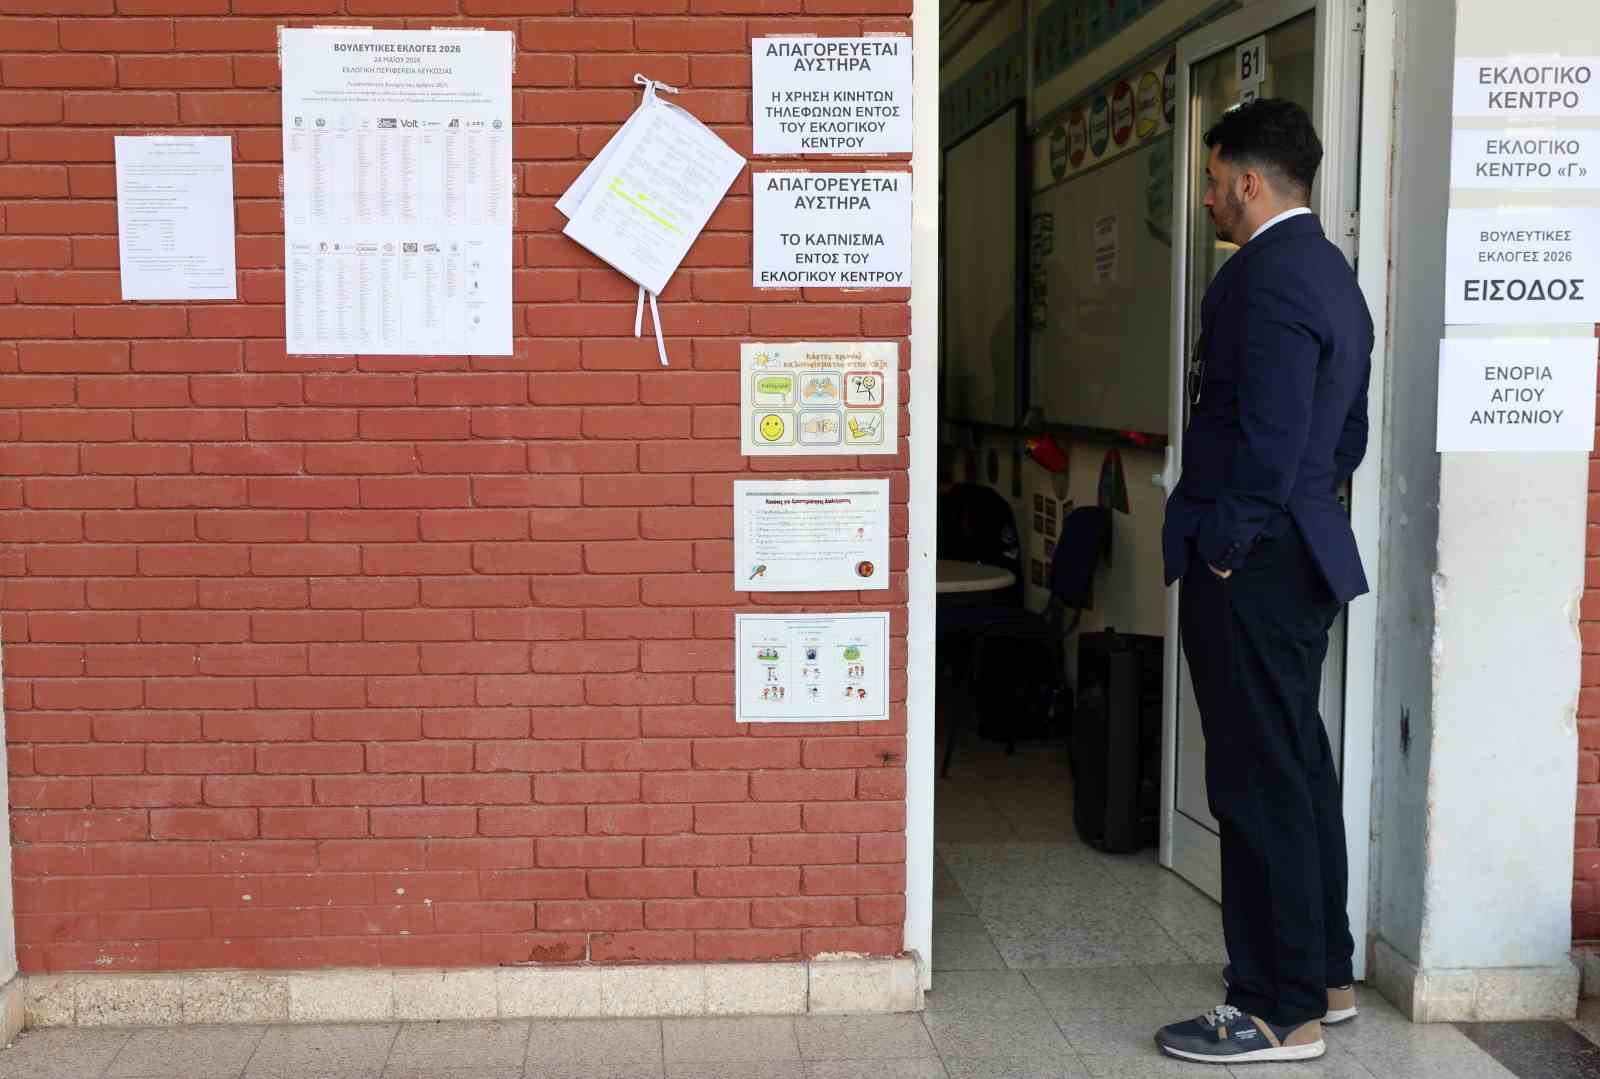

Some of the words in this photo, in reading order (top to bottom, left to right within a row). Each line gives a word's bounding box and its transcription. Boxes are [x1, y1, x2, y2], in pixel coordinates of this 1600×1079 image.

[334, 44, 395, 52] ΒΟΥΛΕΥΤΙΚΕΣ
[397, 44, 437, 53] ΕΚΛΟΓΕΣ
[439, 45, 461, 53] 2026
[766, 42, 898, 56] ΑΠΑΓΟΡΕΥΕΤΑΙ
[794, 58, 871, 72] ΑΥΣΤΗΡΑ
[1479, 66, 1592, 84] ΕΚΛΟΓΙΚΟ
[772, 92, 780, 102] Η
[785, 92, 829, 102] ΧΡΗΣΗ
[834, 91, 893, 102] ΚΙΝΗΤΩΝ
[1488, 91, 1579, 108] ΚΕΝΤΡΟ
[766, 106, 851, 117] ΤΗΛΕΦΩΝΩΝ
[856, 106, 900, 117] ΕΝΤΟΣ
[400, 118, 418, 128] Volt
[780, 122, 806, 133] ΤΟΥ
[810, 122, 886, 133] ΕΚΛΟΓΙΚΟΥ
[802, 138, 864, 148] ΚΕΝΤΡΟΥ
[1486, 140, 1580, 154] ΕΚΛΟΓΙΚΟ
[1476, 162, 1552, 177] ΚΕΝΤΡΟ
[1558, 162, 1587, 177] «Γ»
[767, 178, 898, 192] ΑΠΑΓΟΡΕΥΕΤΑΙ
[794, 196, 871, 210] ΑΥΣΤΗΡΑ
[780, 234, 801, 246] ΤΟ
[806, 234, 885, 246] ΚΑΠΝΙΣΜΑ
[1480, 230, 1572, 242] ΒΟΥΛΕΥΤΙΚΕΣ
[796, 253, 840, 264] ΕΝΤΟΣ
[844, 253, 870, 264] ΤΟΥ
[1478, 252, 1539, 262] ΕΚΛΟΓΕΣ
[1544, 251, 1572, 262] 2026
[761, 271, 836, 282] ΕΚΛΟΓΙΚΟΥ
[841, 271, 904, 282] ΚΕΝΤΡΟΥ
[1464, 278, 1584, 301] ΕΙΣΟΔΟΣ
[1484, 366, 1552, 381] ΕΝΟΡΙΑ
[1490, 388, 1544, 402] ΑΓΙΟΥ
[1470, 410, 1564, 424] ΑΝΤΩΝΙΟΥ
